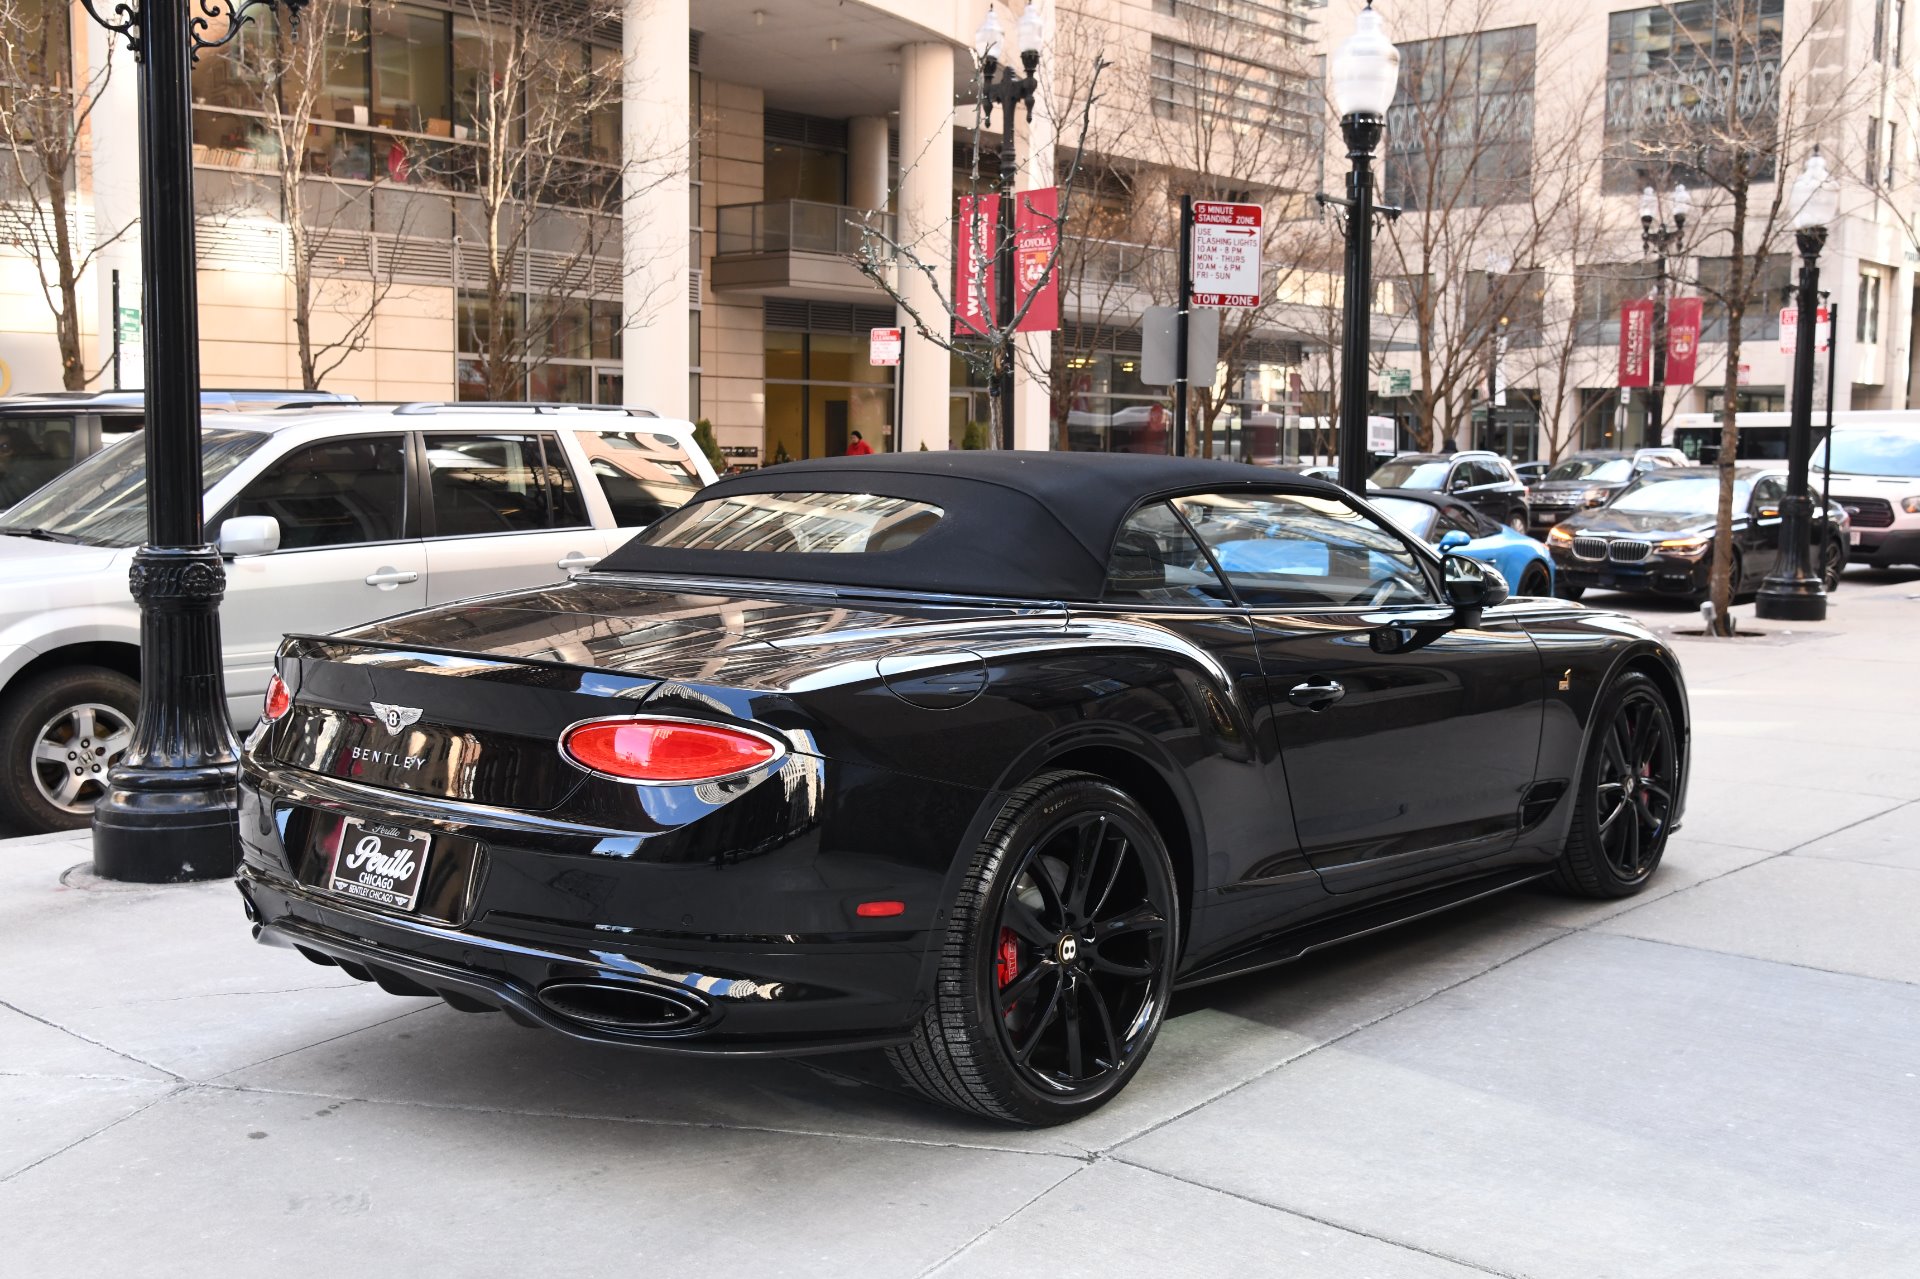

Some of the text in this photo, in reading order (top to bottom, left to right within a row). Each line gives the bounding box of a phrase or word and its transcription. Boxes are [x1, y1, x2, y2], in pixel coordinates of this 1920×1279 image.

[1198, 205, 1234, 215] 15 MINUTE
[1198, 214, 1255, 225] STANDING ZONE
[1198, 228, 1212, 236] USE
[1020, 237, 1052, 248] LOYOLA
[1198, 237, 1258, 247] FLASHING LIGHTS
[1222, 255, 1245, 263] THURS
[1196, 271, 1209, 279] FRI
[1216, 272, 1231, 280] SUN
[1196, 294, 1254, 306] TOW ZONE
[352, 747, 426, 771] BENTLEY
[372, 825, 400, 837] Perillo
[346, 835, 415, 880] Perillo
[359, 872, 393, 890] CHICAGO
[349, 884, 393, 903] BENTLEY CHICAGO
